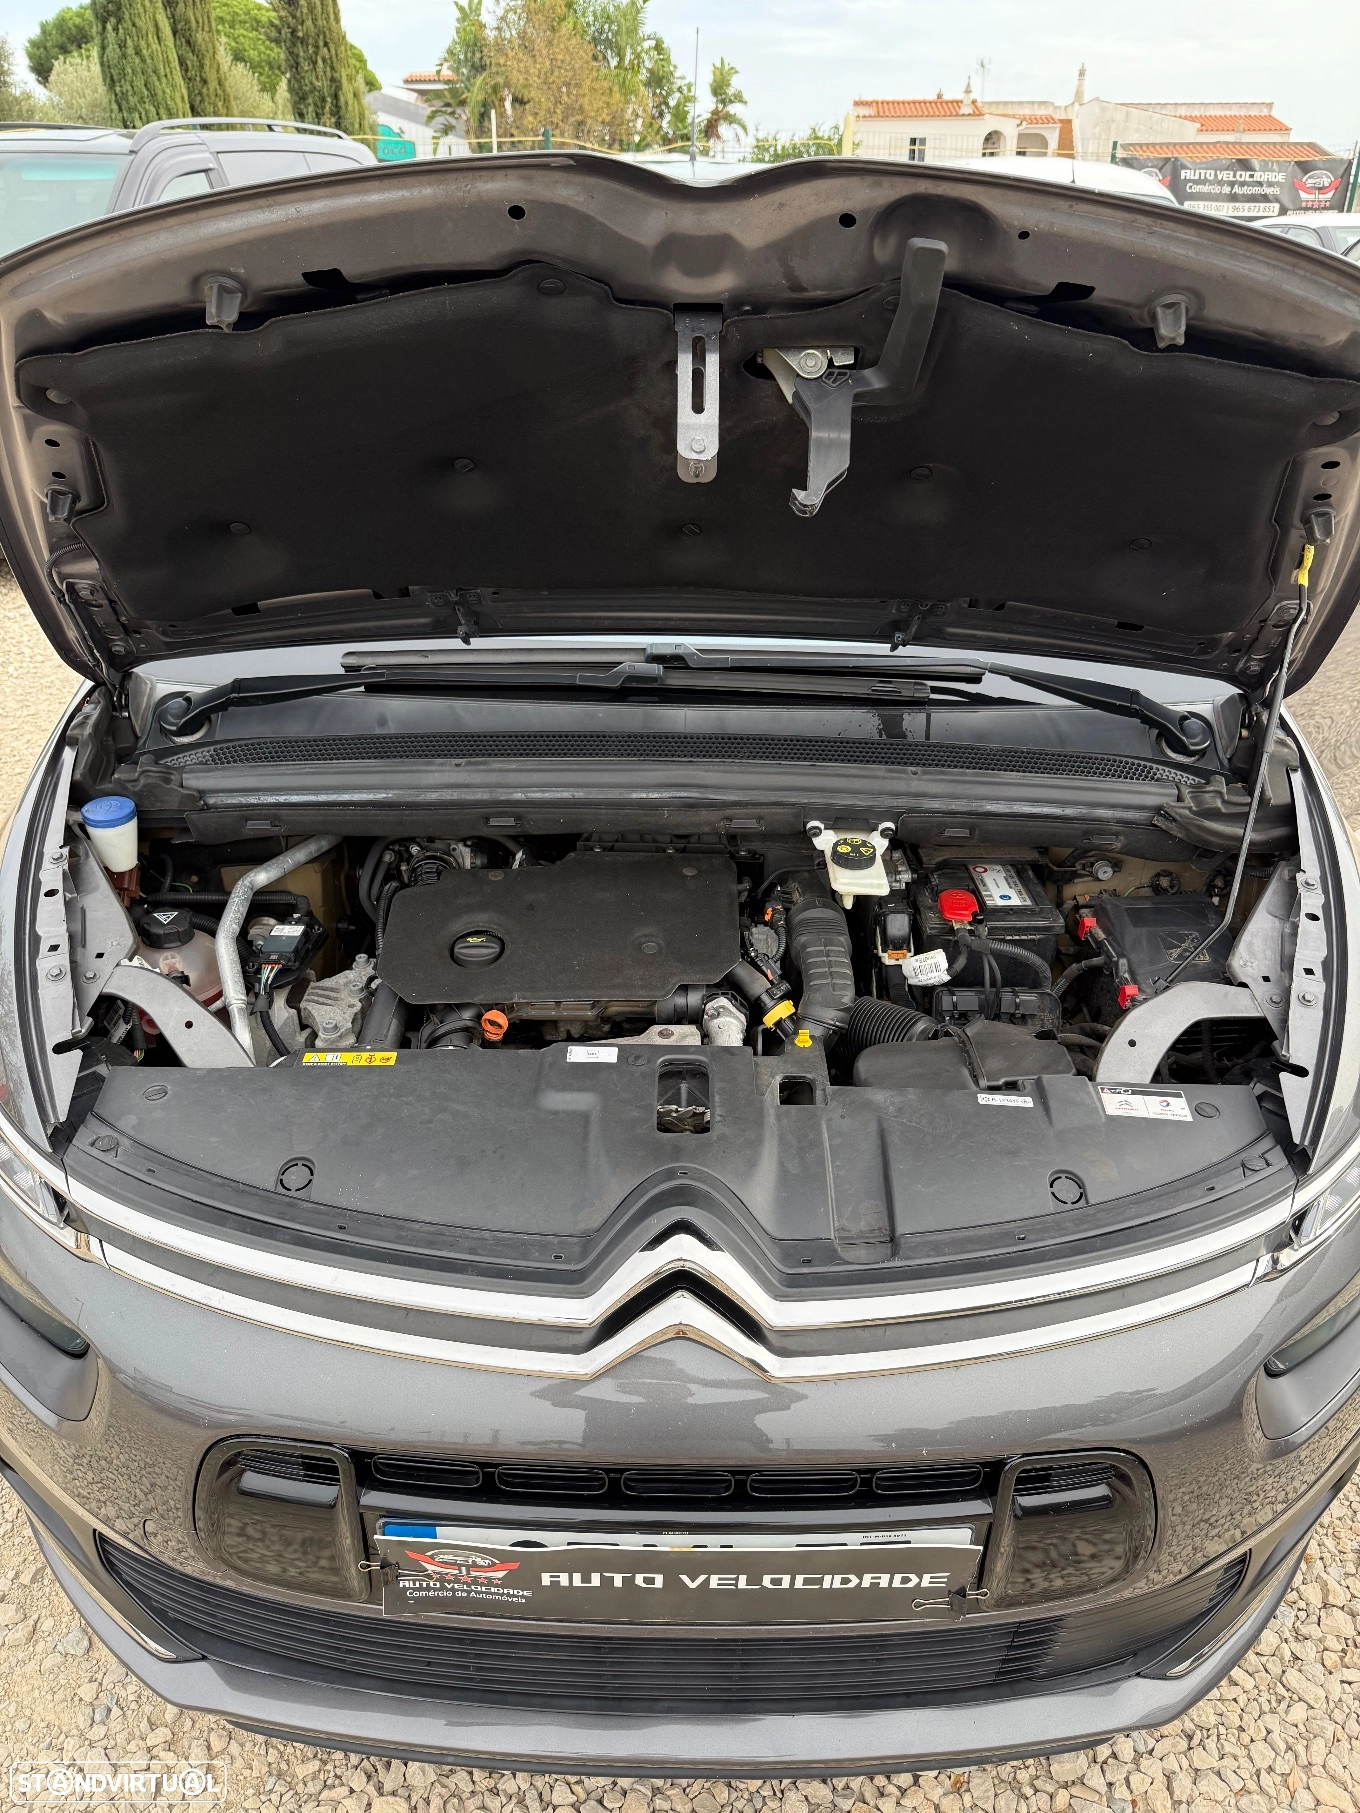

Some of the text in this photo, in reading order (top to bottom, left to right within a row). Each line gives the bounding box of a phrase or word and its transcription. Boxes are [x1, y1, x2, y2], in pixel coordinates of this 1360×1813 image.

[1180, 169, 1287, 182] AUTO VELOCIDADE
[1186, 182, 1280, 195] Comércio de Automóveis
[1231, 205, 1245, 213] 965
[1247, 205, 1261, 213] 673
[540, 1572, 951, 1590] AUTO VELOCIDADE
[399, 1580, 533, 1597] AUTO VELOCIDADE
[406, 1589, 453, 1597] Comércio
[469, 1591, 527, 1603] Automóveis
